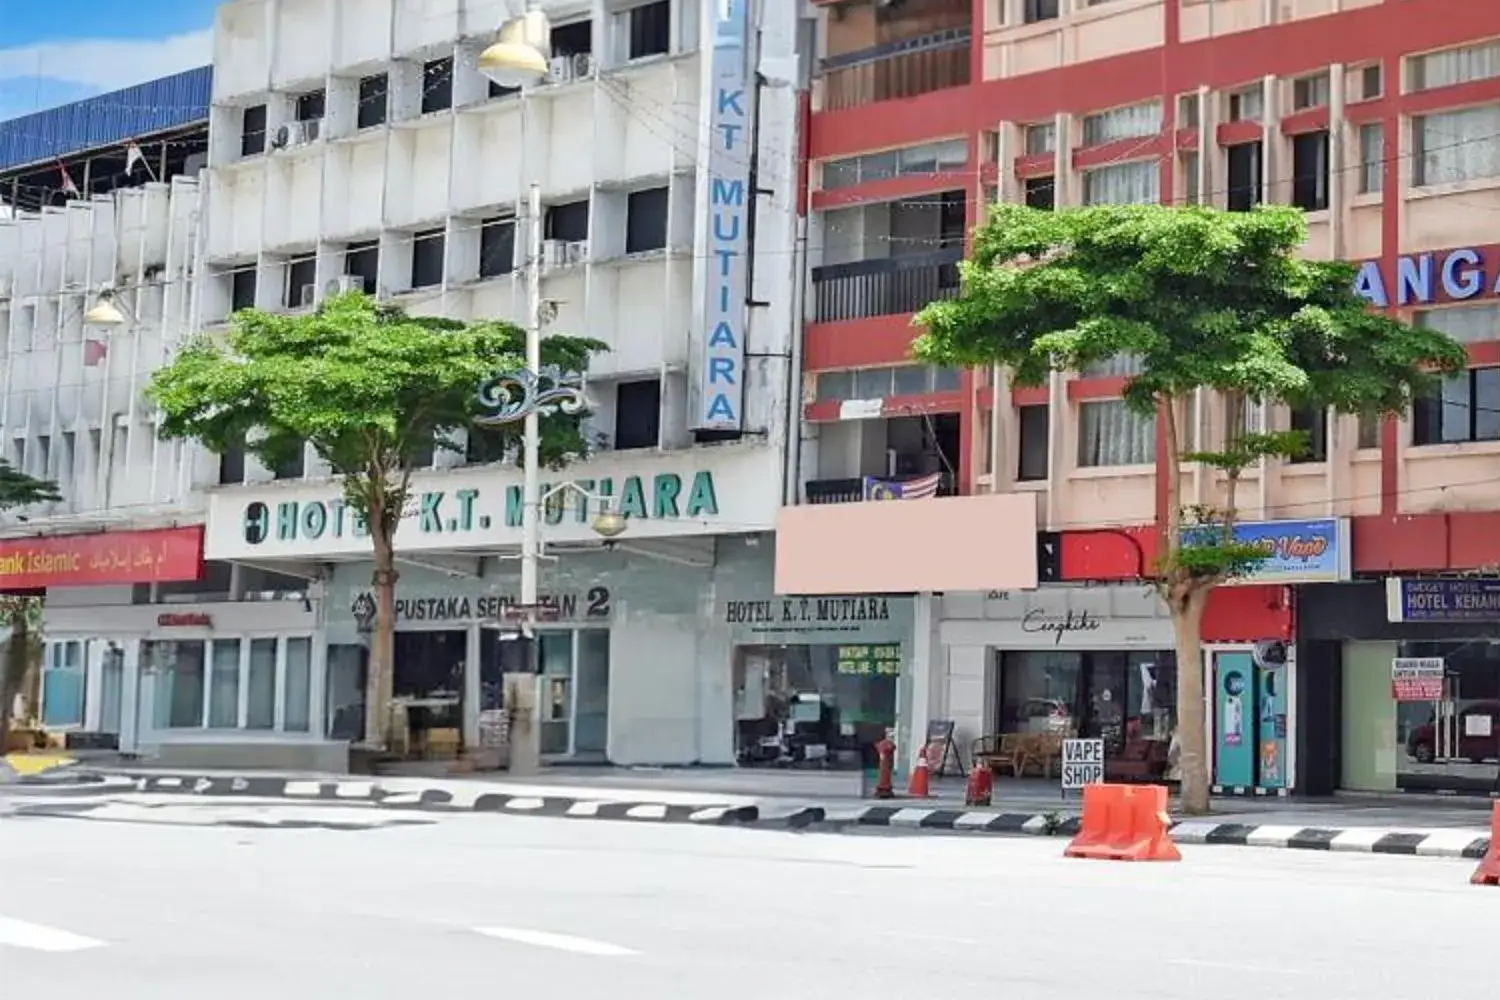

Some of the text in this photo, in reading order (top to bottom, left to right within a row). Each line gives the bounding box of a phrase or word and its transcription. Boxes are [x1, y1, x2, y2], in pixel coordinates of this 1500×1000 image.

[708, 178, 743, 420] MUTIARA
[277, 470, 719, 541] HOTE K.T. MUTIARA
[27, 551, 81, 573] Islamic
[396, 597, 474, 620] PUSTAKA
[587, 586, 609, 616] 2
[727, 597, 890, 623] HOTEL K.T. MUTIARA
[1407, 594, 1449, 609] HOTEL
[1065, 741, 1101, 761] VAPE
[1064, 765, 1101, 785] SHOP
